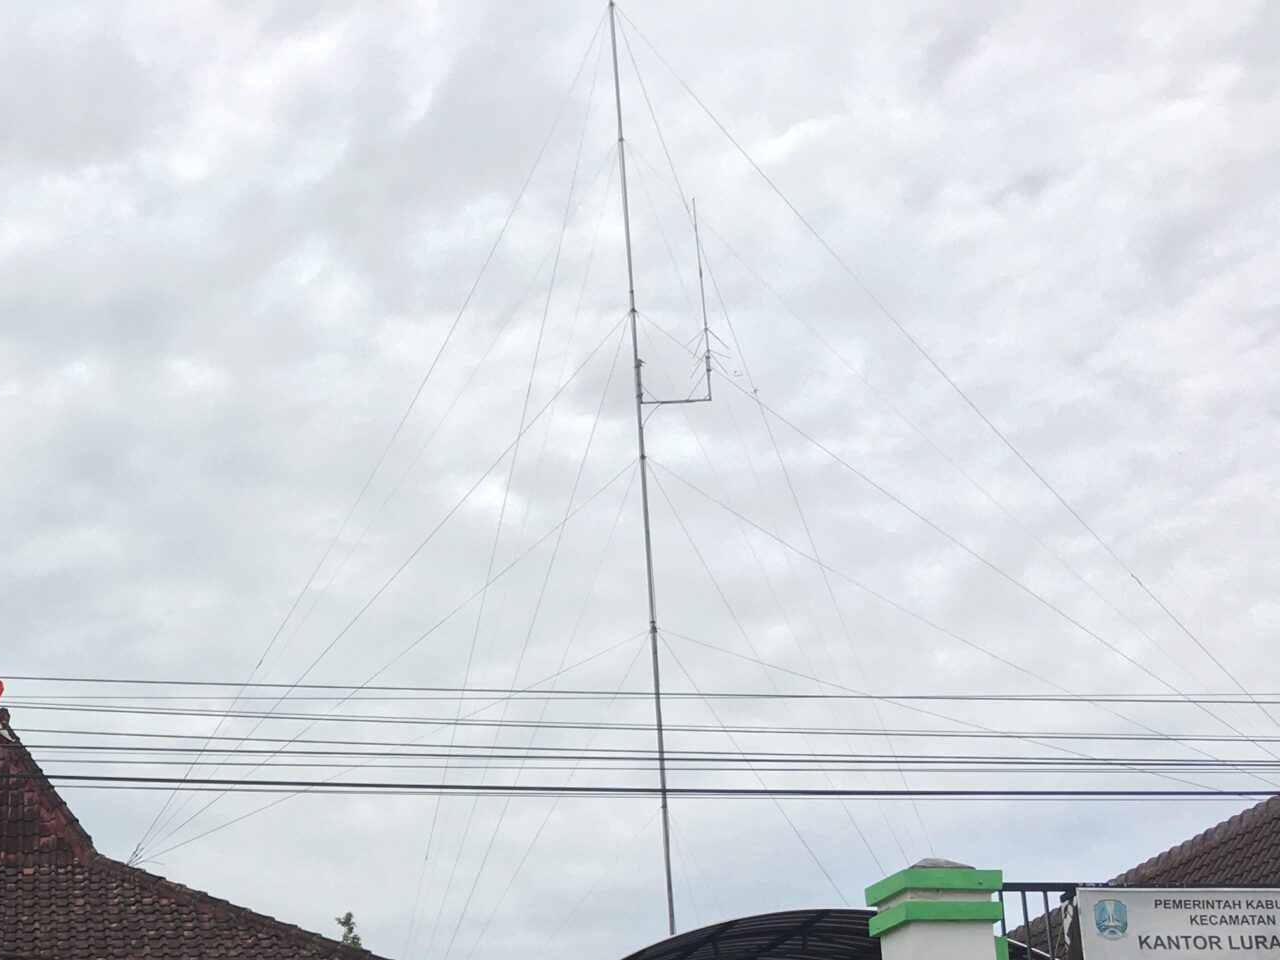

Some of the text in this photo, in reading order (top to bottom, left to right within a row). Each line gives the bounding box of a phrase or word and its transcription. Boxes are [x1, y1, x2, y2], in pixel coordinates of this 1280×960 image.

[1154, 899, 1242, 910] PEMERINTAH
[1189, 914, 1276, 926] KECAMATAN
[1137, 935, 1223, 951] KANTOR
